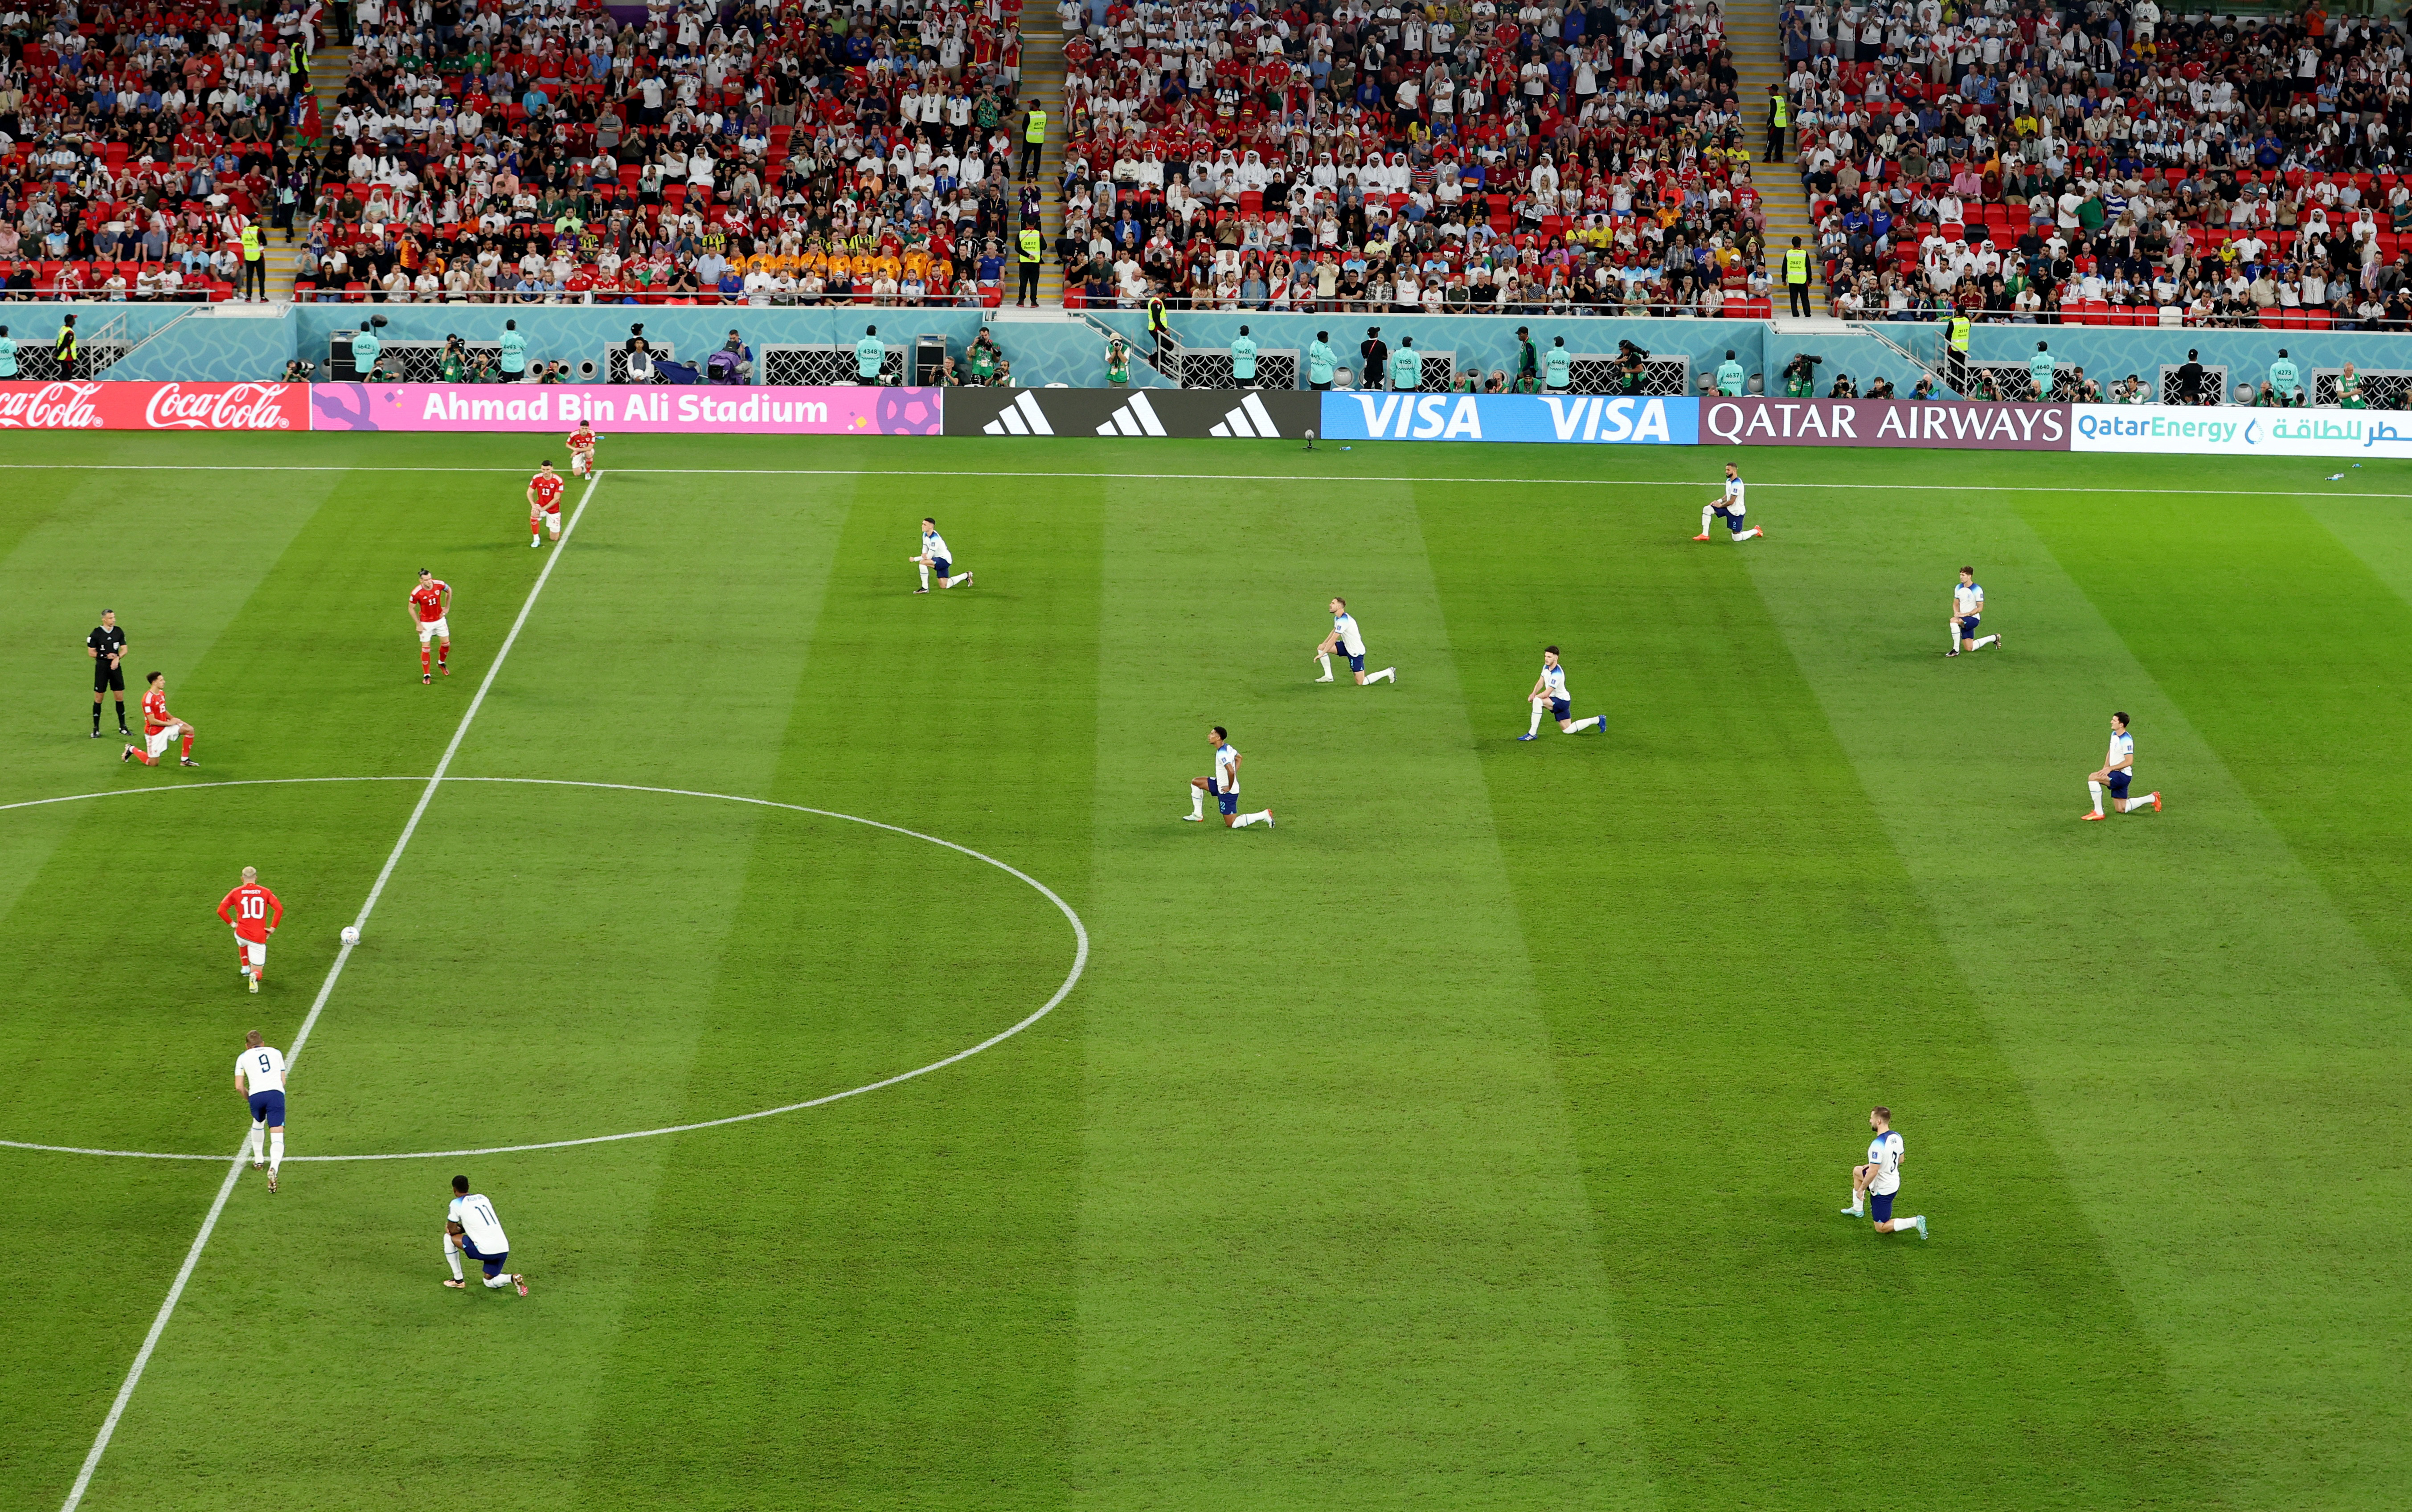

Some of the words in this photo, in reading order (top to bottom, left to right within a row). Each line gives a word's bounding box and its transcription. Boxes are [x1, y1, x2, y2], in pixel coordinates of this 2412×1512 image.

[0, 383, 102, 427] ca-Cola
[146, 383, 289, 428] Coca-Cola
[423, 392, 548, 421] Ahmad
[559, 392, 614, 421] Bin
[623, 392, 669, 421] Ali
[678, 393, 827, 422] Stadium
[1349, 394, 1482, 439] VISA
[1537, 397, 1670, 441] VISA
[1708, 403, 1858, 445] QATAR
[1876, 406, 2063, 441] AIRWAYS
[2079, 415, 2237, 442] QatarEnergy
[2273, 419, 2361, 440] للطاقة
[428, 598, 436, 606] 11
[240, 897, 265, 919] 10
[259, 1054, 270, 1073] 9
[1891, 1150, 1897, 1172] 3
[475, 1204, 496, 1226] 11
